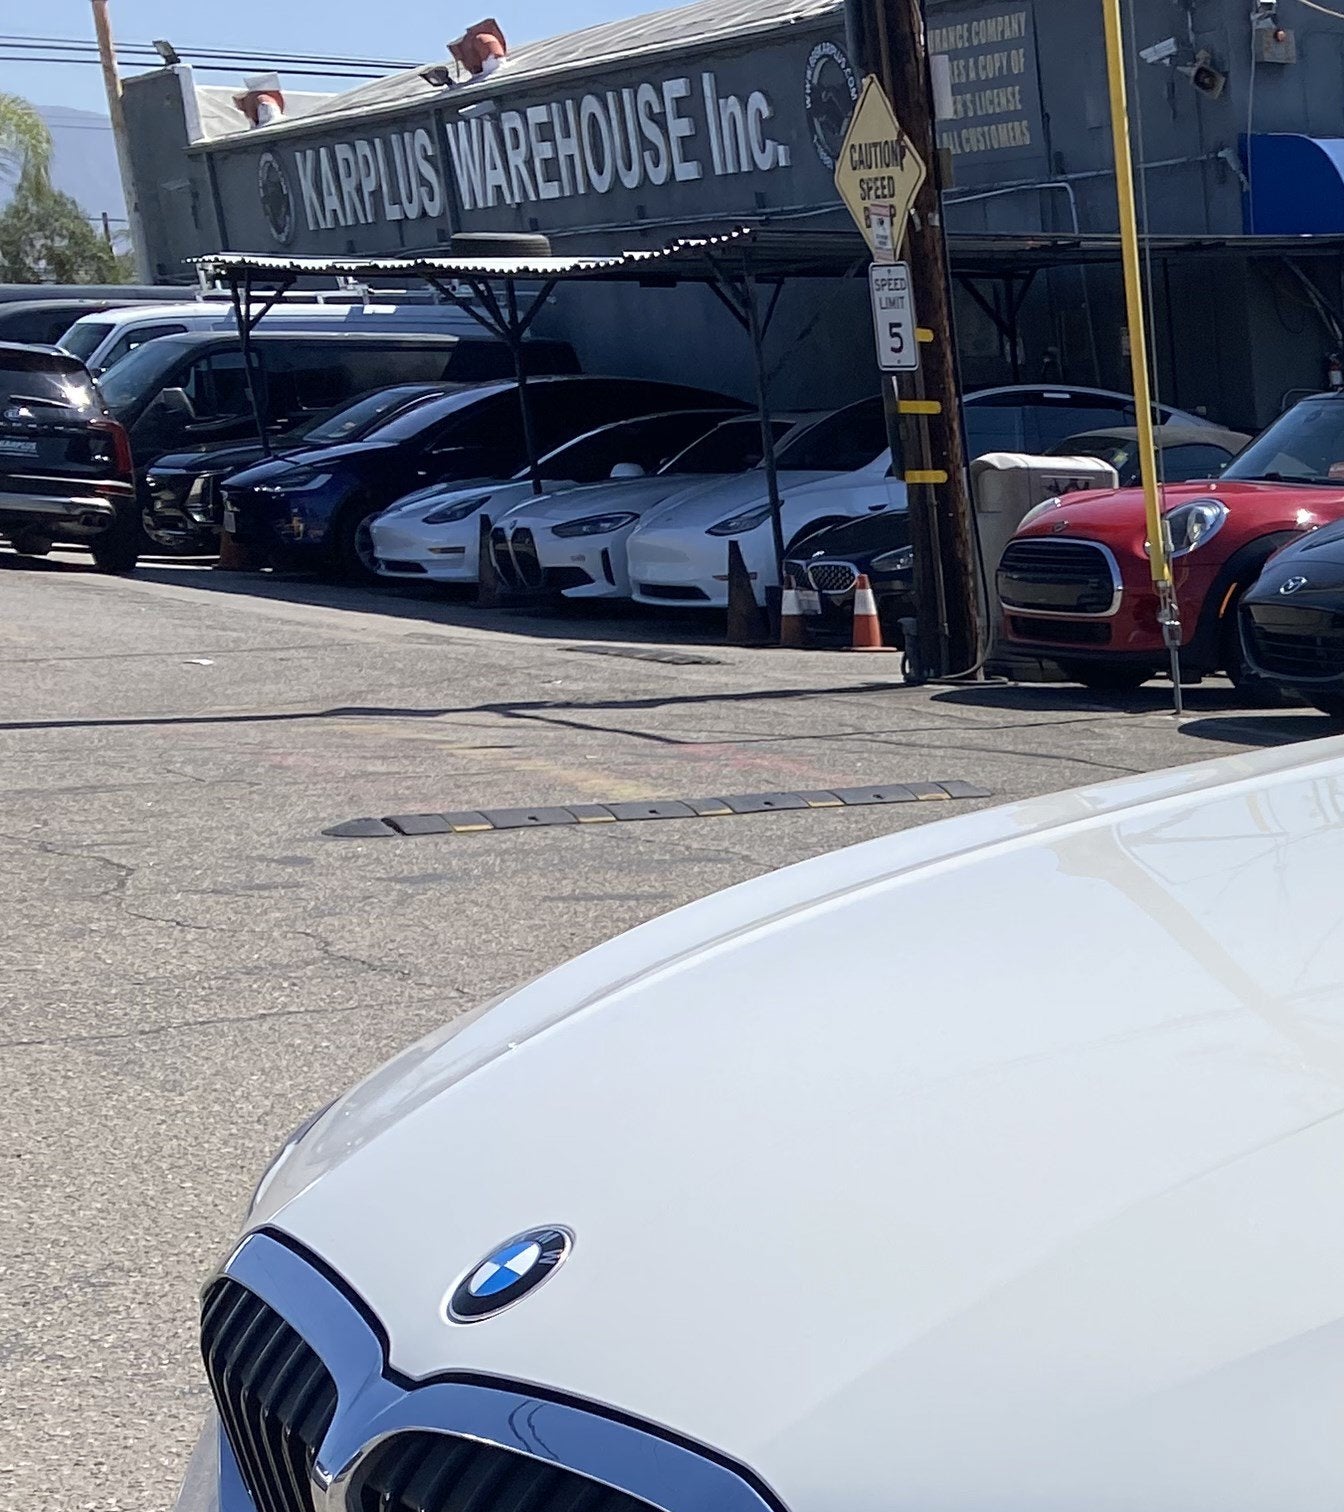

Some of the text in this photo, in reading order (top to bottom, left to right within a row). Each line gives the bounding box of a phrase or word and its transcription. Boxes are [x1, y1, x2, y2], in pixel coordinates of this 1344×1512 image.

[971, 12, 1026, 46] COMPANY
[968, 58, 977, 81] A
[978, 51, 1008, 80] COPY
[1010, 48, 1025, 74] OF
[975, 86, 1022, 116] LICENSE
[295, 127, 443, 231] KARPLUS
[446, 77, 703, 211] WAREHOUSE
[702, 72, 792, 175] Inc.
[961, 120, 1031, 153] CUSTOMERS
[850, 139, 904, 172] CAUTION
[859, 175, 896, 201] SPEED
[863, 204, 896, 229] BP
[874, 278, 907, 292] SPEED
[879, 296, 905, 310] LIMIT
[888, 322, 904, 353] 5
